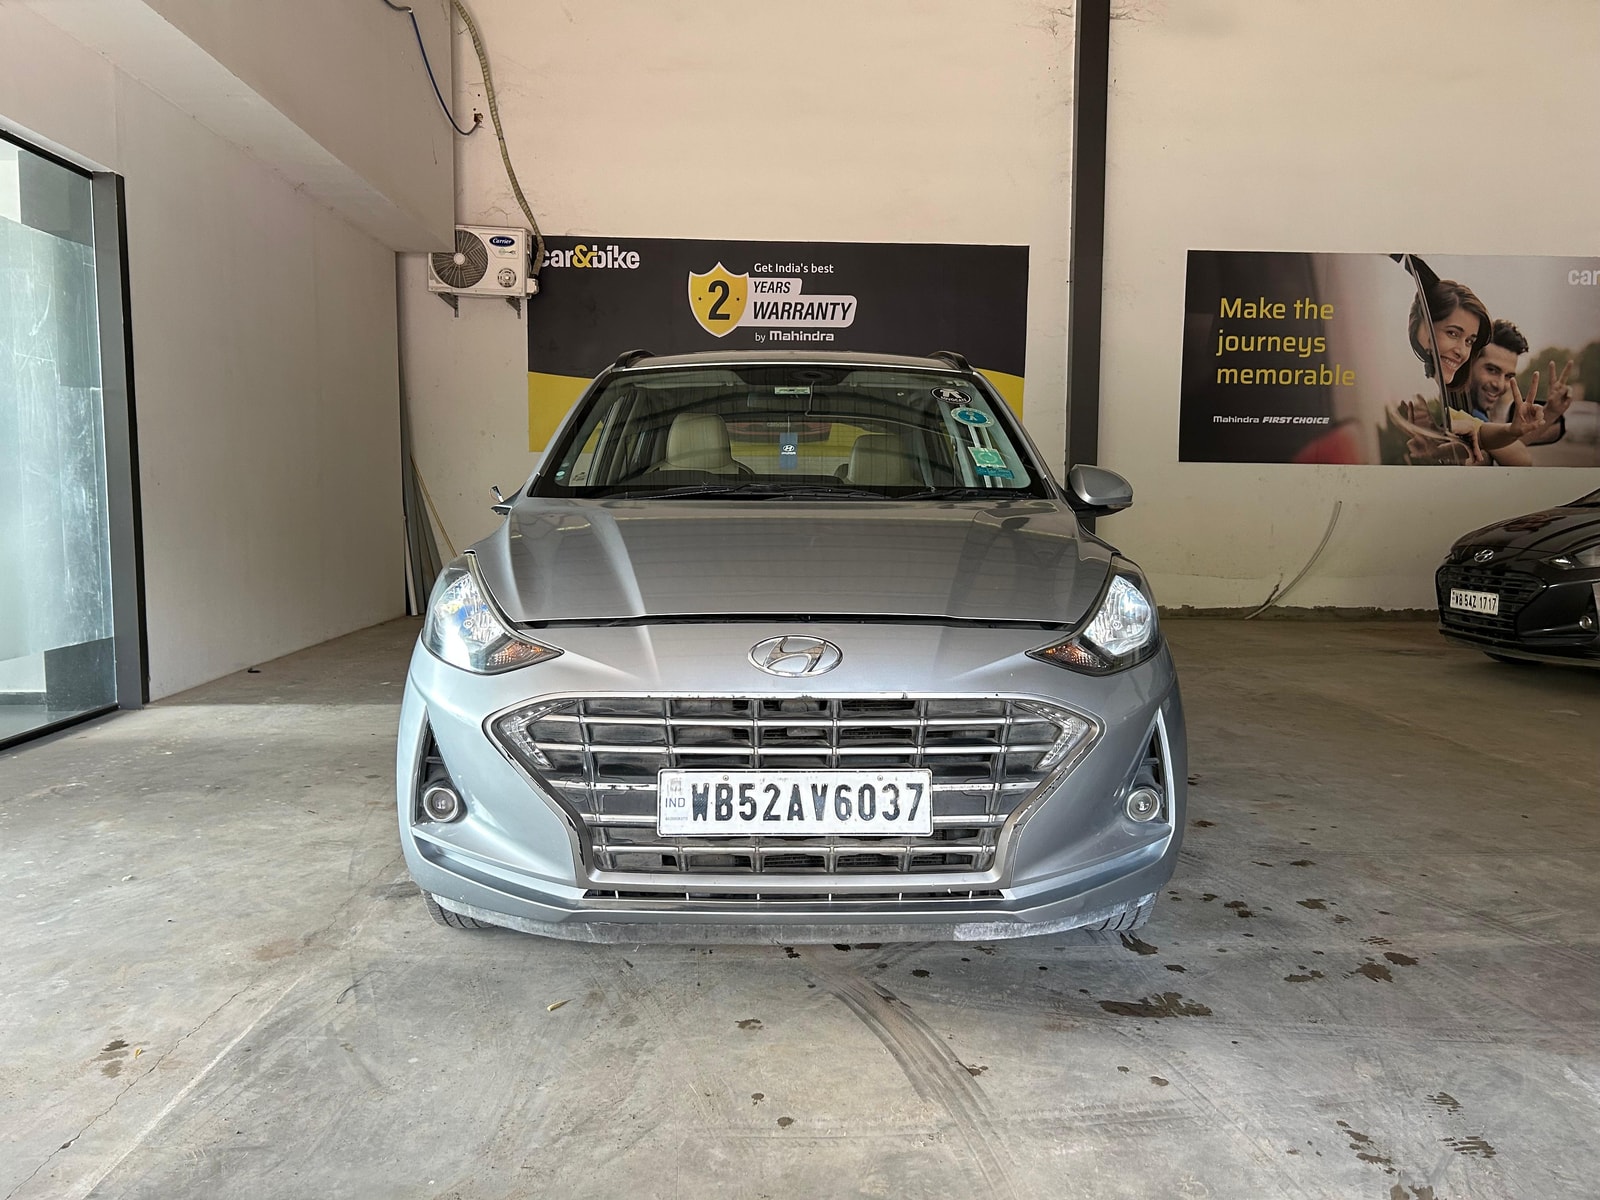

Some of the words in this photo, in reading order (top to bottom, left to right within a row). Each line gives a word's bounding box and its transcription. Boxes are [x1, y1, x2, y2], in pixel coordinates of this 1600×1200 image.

[492, 237, 512, 245] Carrier
[753, 262, 773, 273] Get
[775, 262, 809, 273] India's
[811, 263, 834, 274] best
[1567, 270, 1600, 285] car
[753, 281, 791, 294] YEARS
[708, 280, 731, 320] 2
[753, 301, 853, 321] WARRANTY
[1220, 296, 1286, 319] Make
[1293, 297, 1334, 320] the
[755, 332, 766, 344] by
[769, 330, 834, 342] Mahindra
[1215, 329, 1326, 358] journeys
[1216, 363, 1356, 386] memorable
[1213, 415, 1260, 424] Mahindra
[1262, 416, 1292, 424] FIRST
[1292, 416, 1330, 425] CHOICE
[1479, 596, 1497, 611] 1717
[665, 797, 686, 808] IND
[691, 783, 924, 822] WB52AV6037
